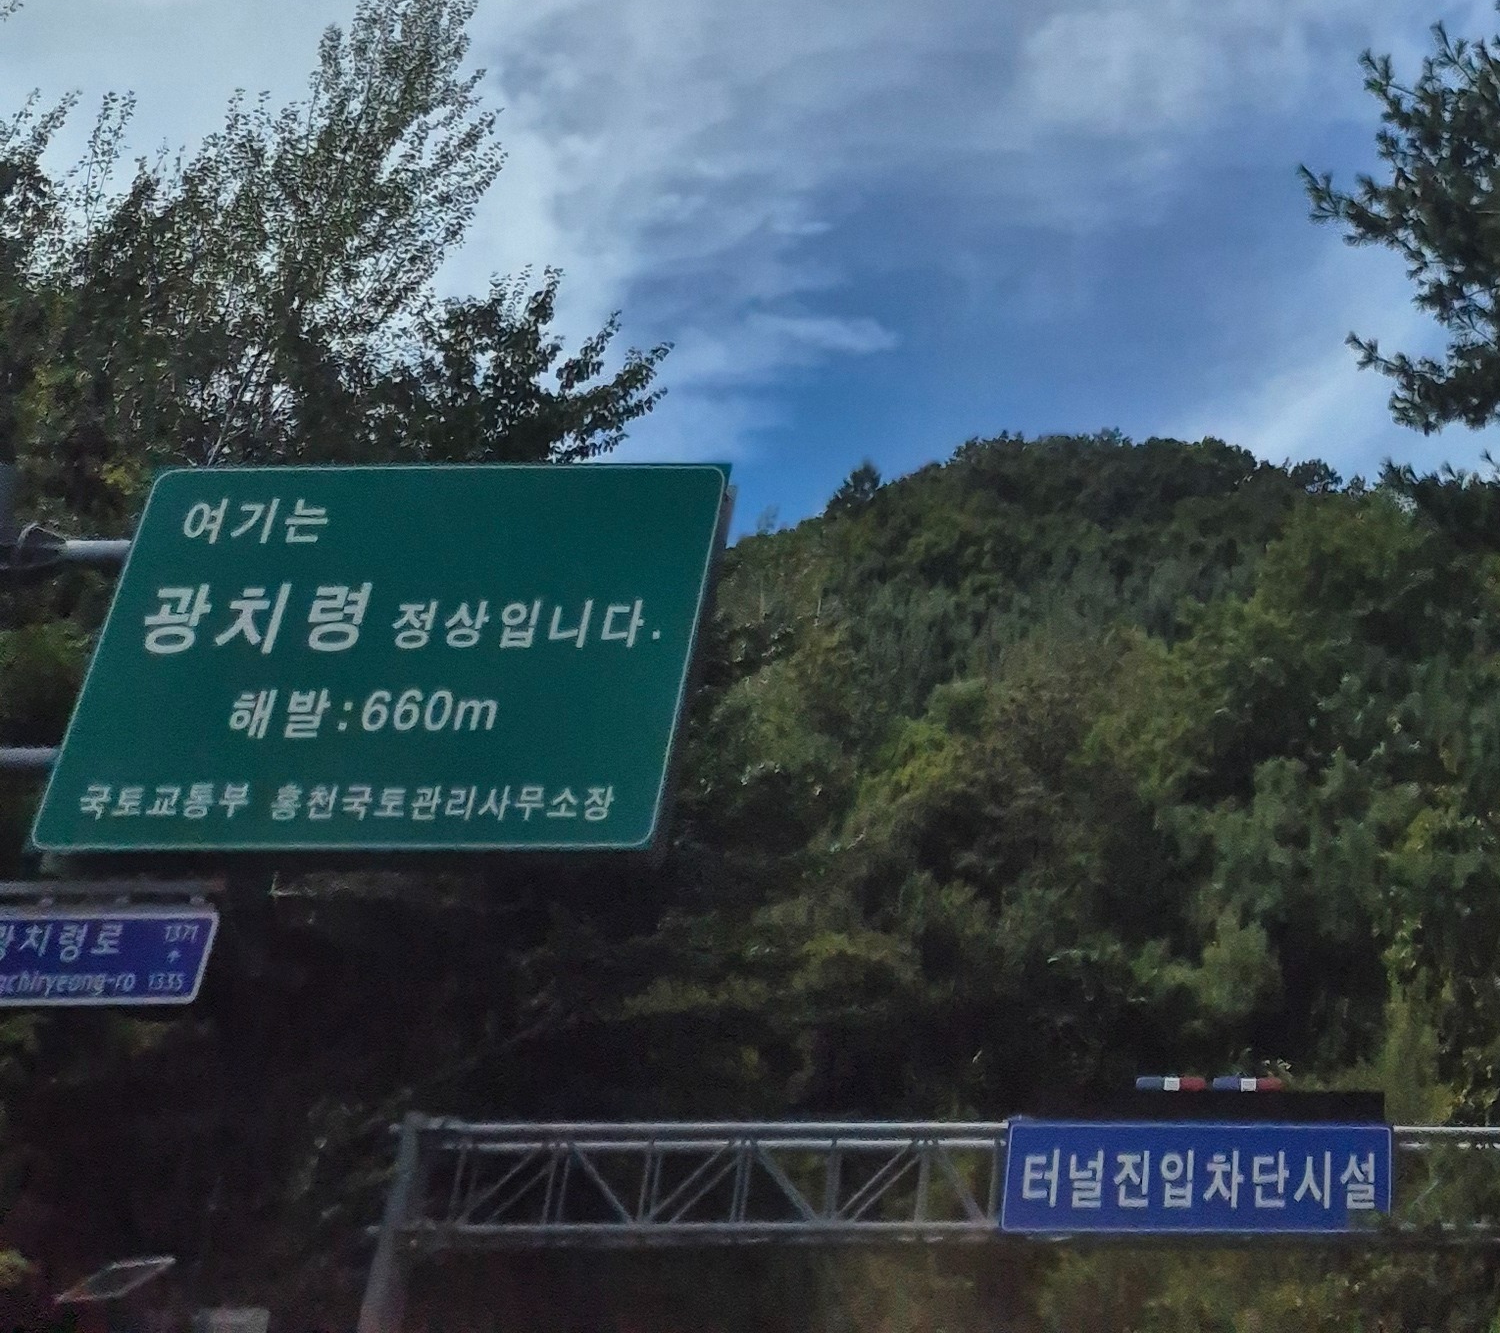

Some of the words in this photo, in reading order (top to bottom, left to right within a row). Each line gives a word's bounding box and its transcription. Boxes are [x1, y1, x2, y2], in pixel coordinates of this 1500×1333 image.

[183, 498, 329, 545] 여기는
[143, 581, 373, 654] 광치령
[390, 599, 661, 650] 정상입니다.
[79, 783, 250, 821] 국토교통부
[270, 783, 615, 821] 홍천국토관리사무소장
[1022, 1148, 1376, 1210] 터널진입차단시설
